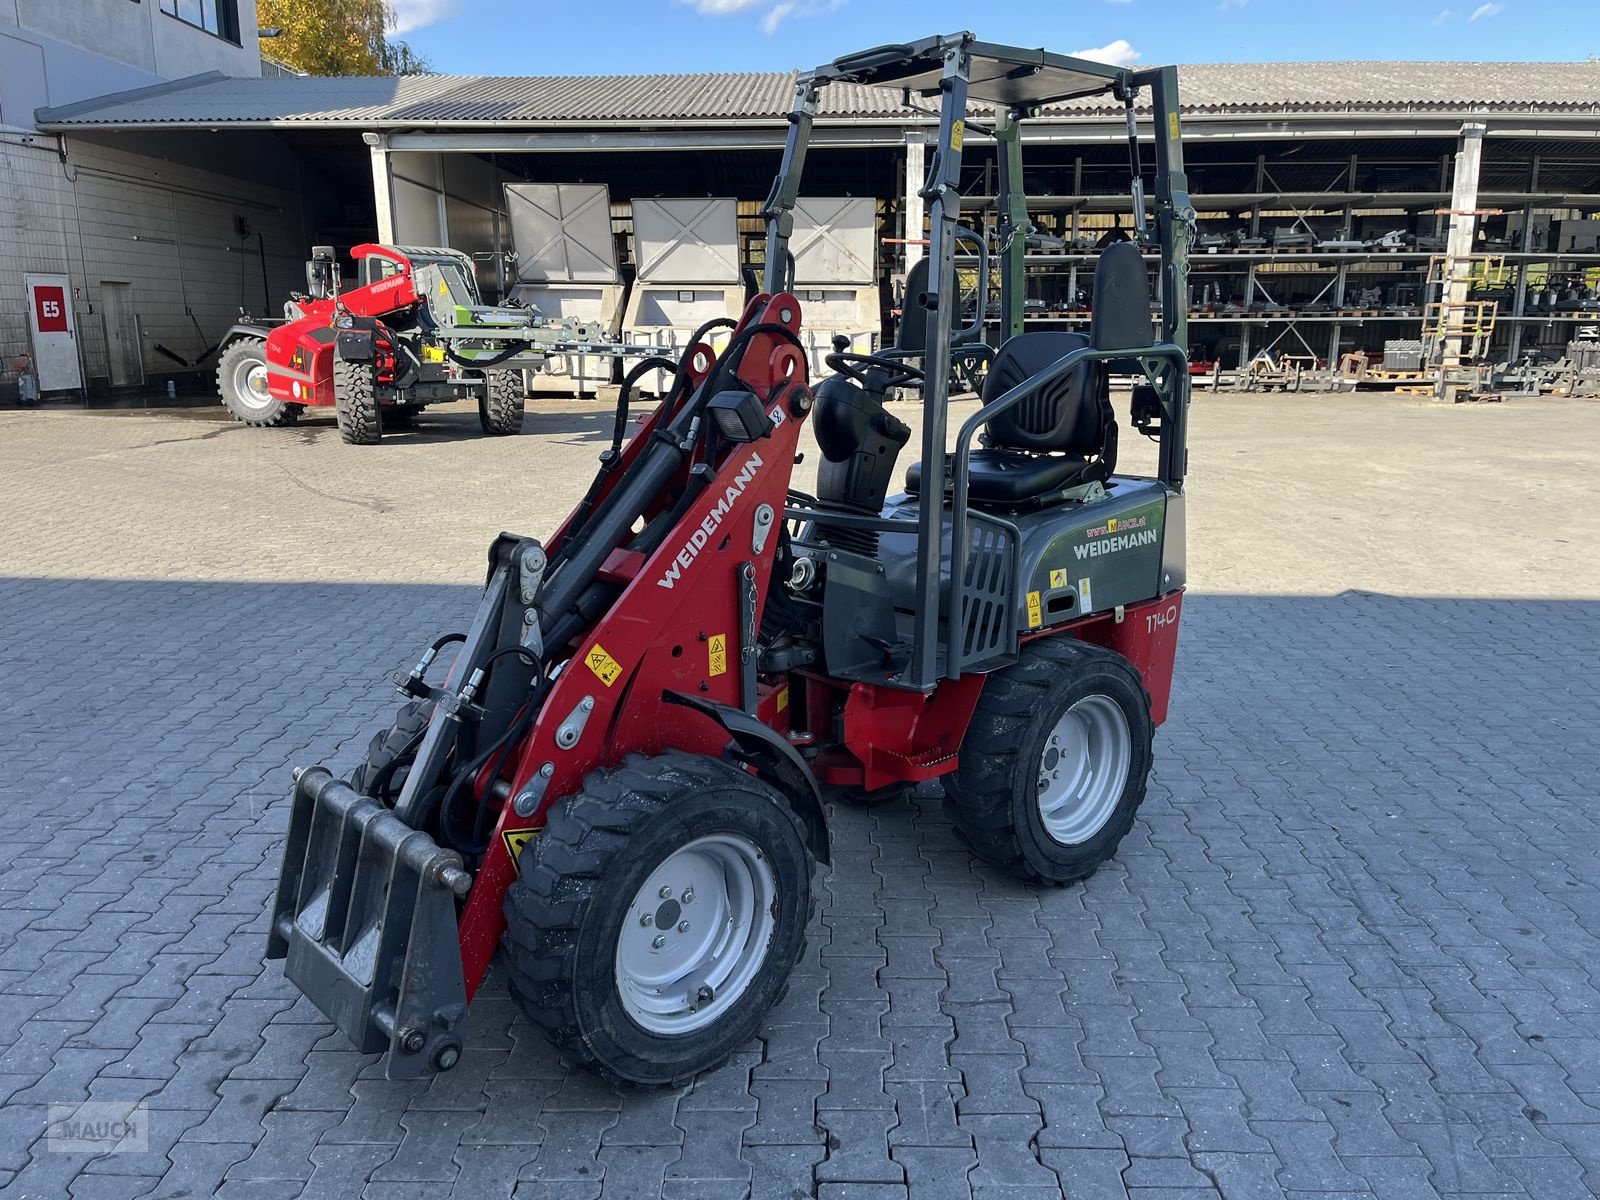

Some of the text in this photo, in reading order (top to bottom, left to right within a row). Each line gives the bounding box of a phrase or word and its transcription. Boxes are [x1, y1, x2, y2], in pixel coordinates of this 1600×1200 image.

[42, 301, 60, 318] E5
[657, 452, 764, 589] WEIDEMANN
[1073, 529, 1157, 560] WEIDEMANN
[1146, 605, 1177, 634] 1140
